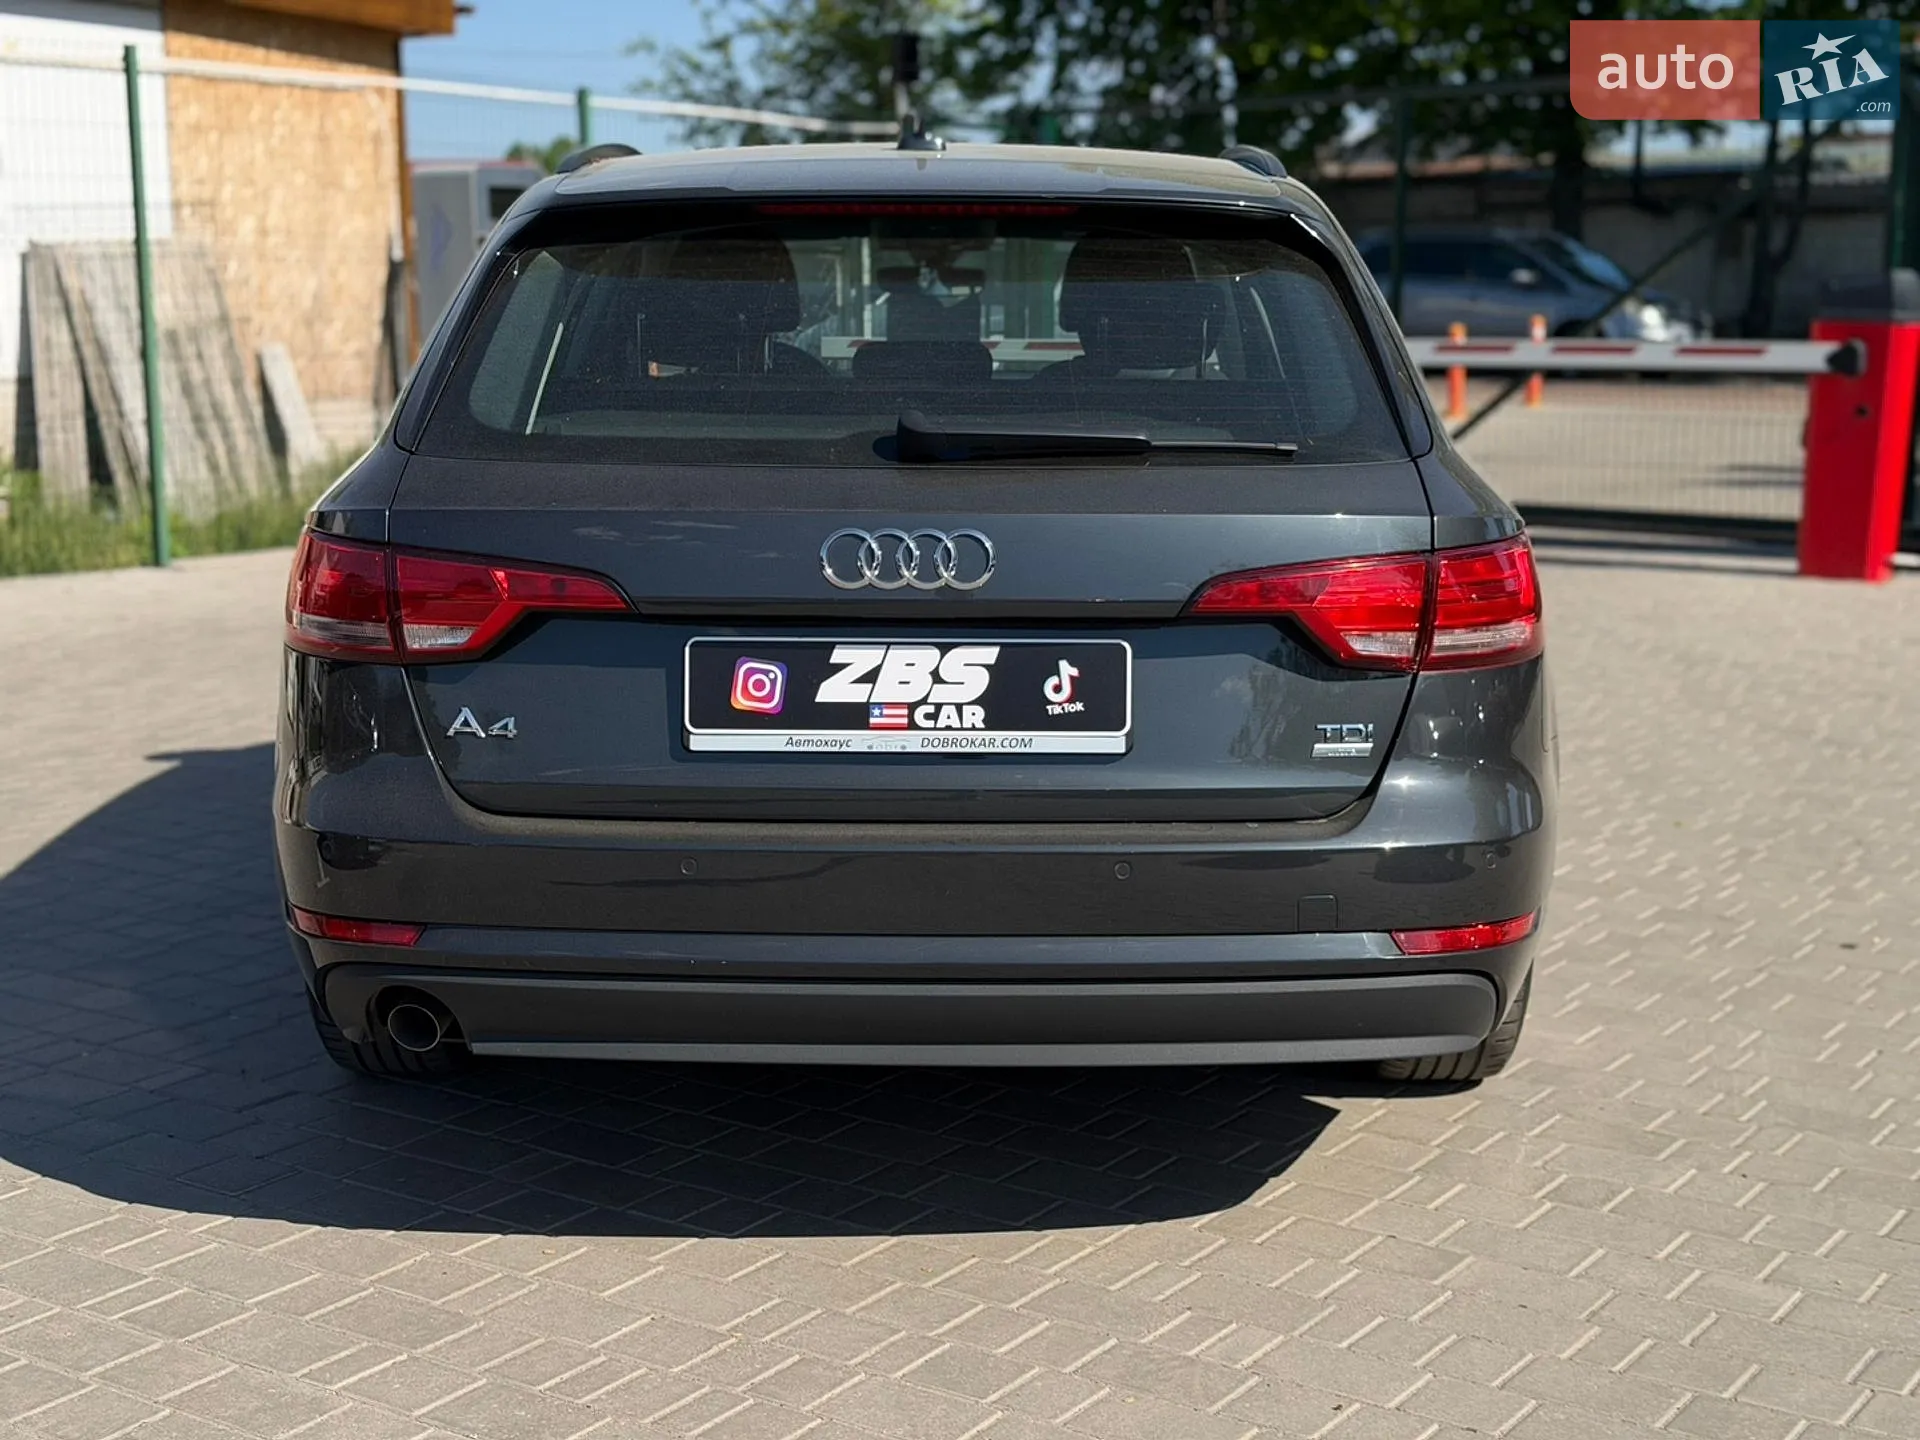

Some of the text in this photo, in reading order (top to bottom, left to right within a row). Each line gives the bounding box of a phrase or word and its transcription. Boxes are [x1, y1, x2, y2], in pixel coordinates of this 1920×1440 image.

[815, 645, 1000, 703] ZBS
[913, 704, 986, 728] CAR
[1045, 701, 1085, 715] TikTok
[446, 706, 517, 738] A4
[1314, 723, 1373, 742] TDI
[784, 736, 853, 749] Автохаус
[920, 737, 1033, 749] DOBROKAR.COM
